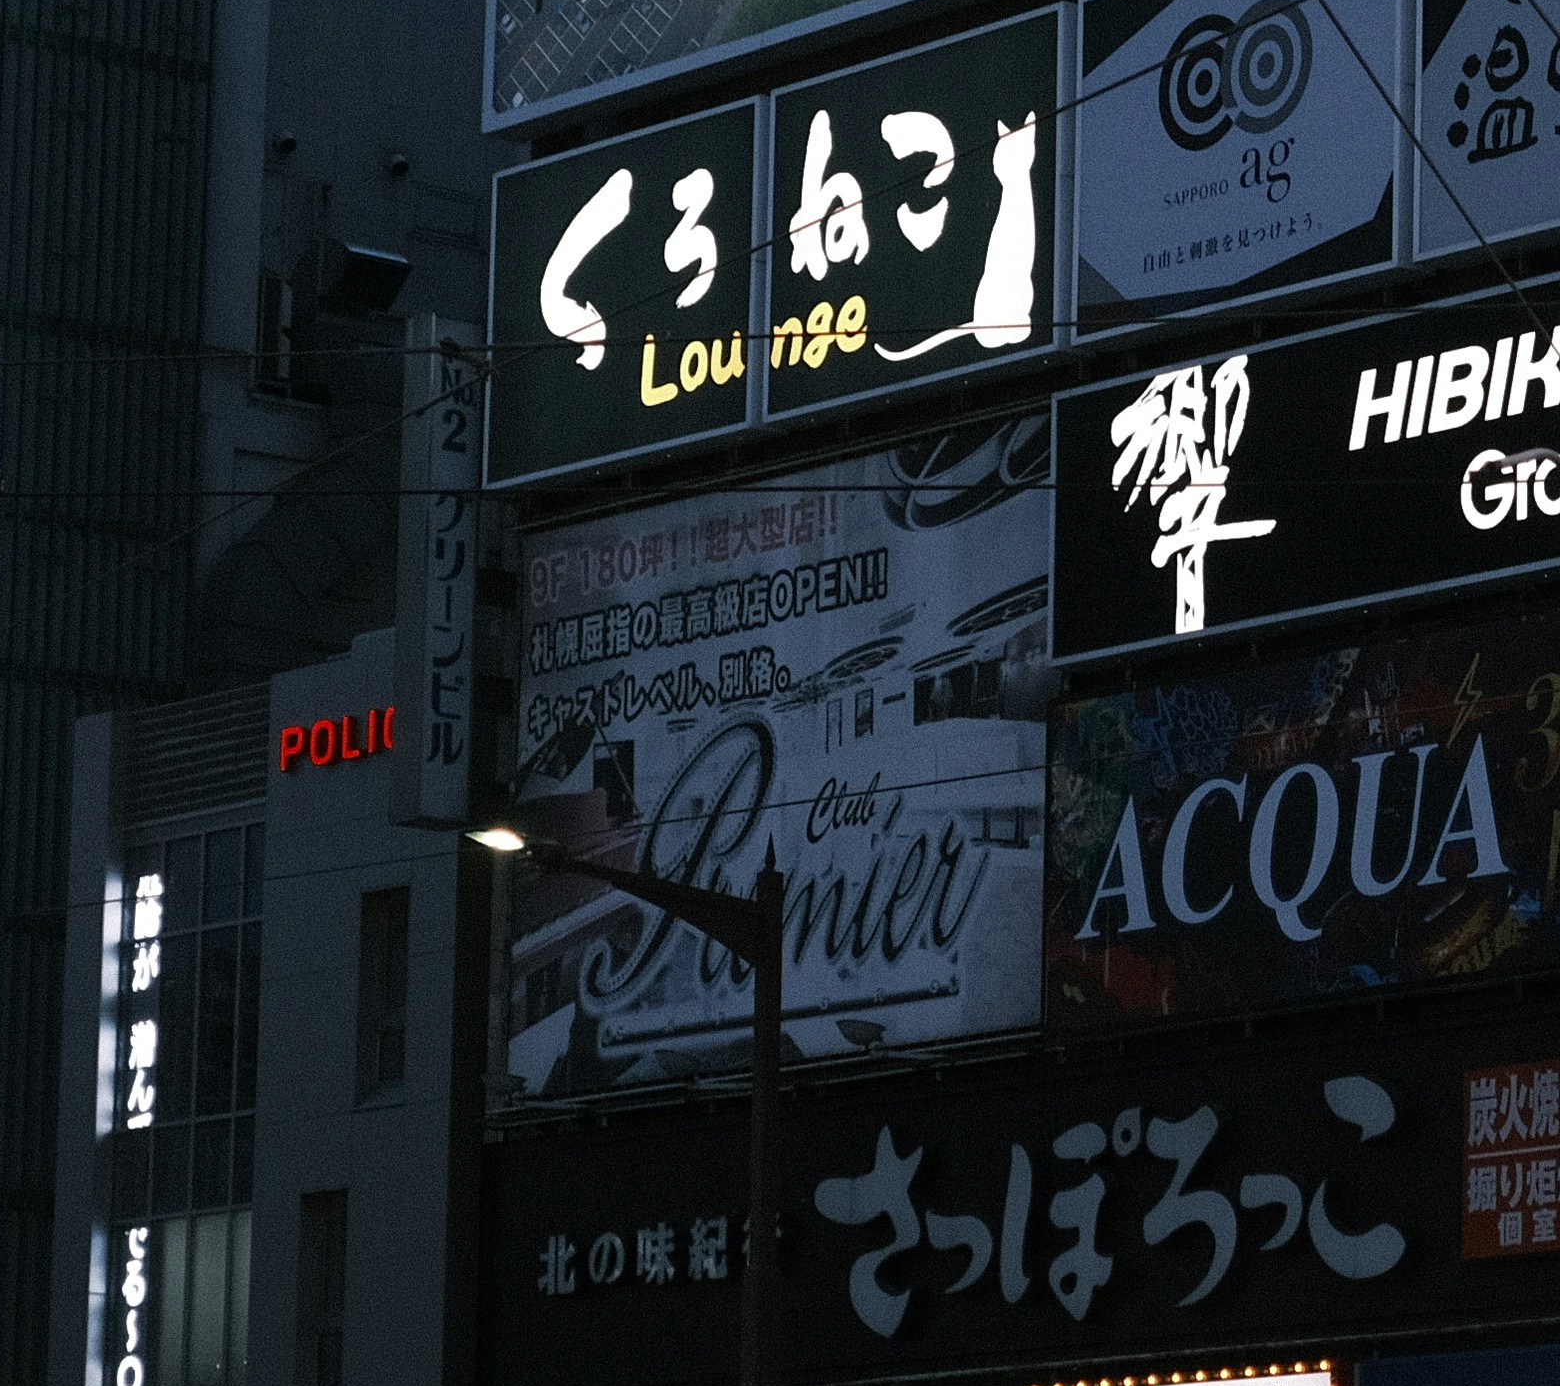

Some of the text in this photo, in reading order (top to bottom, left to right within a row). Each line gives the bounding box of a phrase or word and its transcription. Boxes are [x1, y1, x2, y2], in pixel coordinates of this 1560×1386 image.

[540, 109, 955, 371] くろねこ
[1143, 214, 1326, 276] 自由と刺激を見つけよう。
[1163, 137, 1295, 210] SAPPORO ag
[641, 295, 868, 407] Lounge
[1110, 354, 1276, 634] 響
[529, 547, 888, 675] 札幌屈指の最高級店OPEN!!
[1074, 731, 1509, 941] ACQUA
[815, 1076, 1407, 1338] さっぽろっこ
